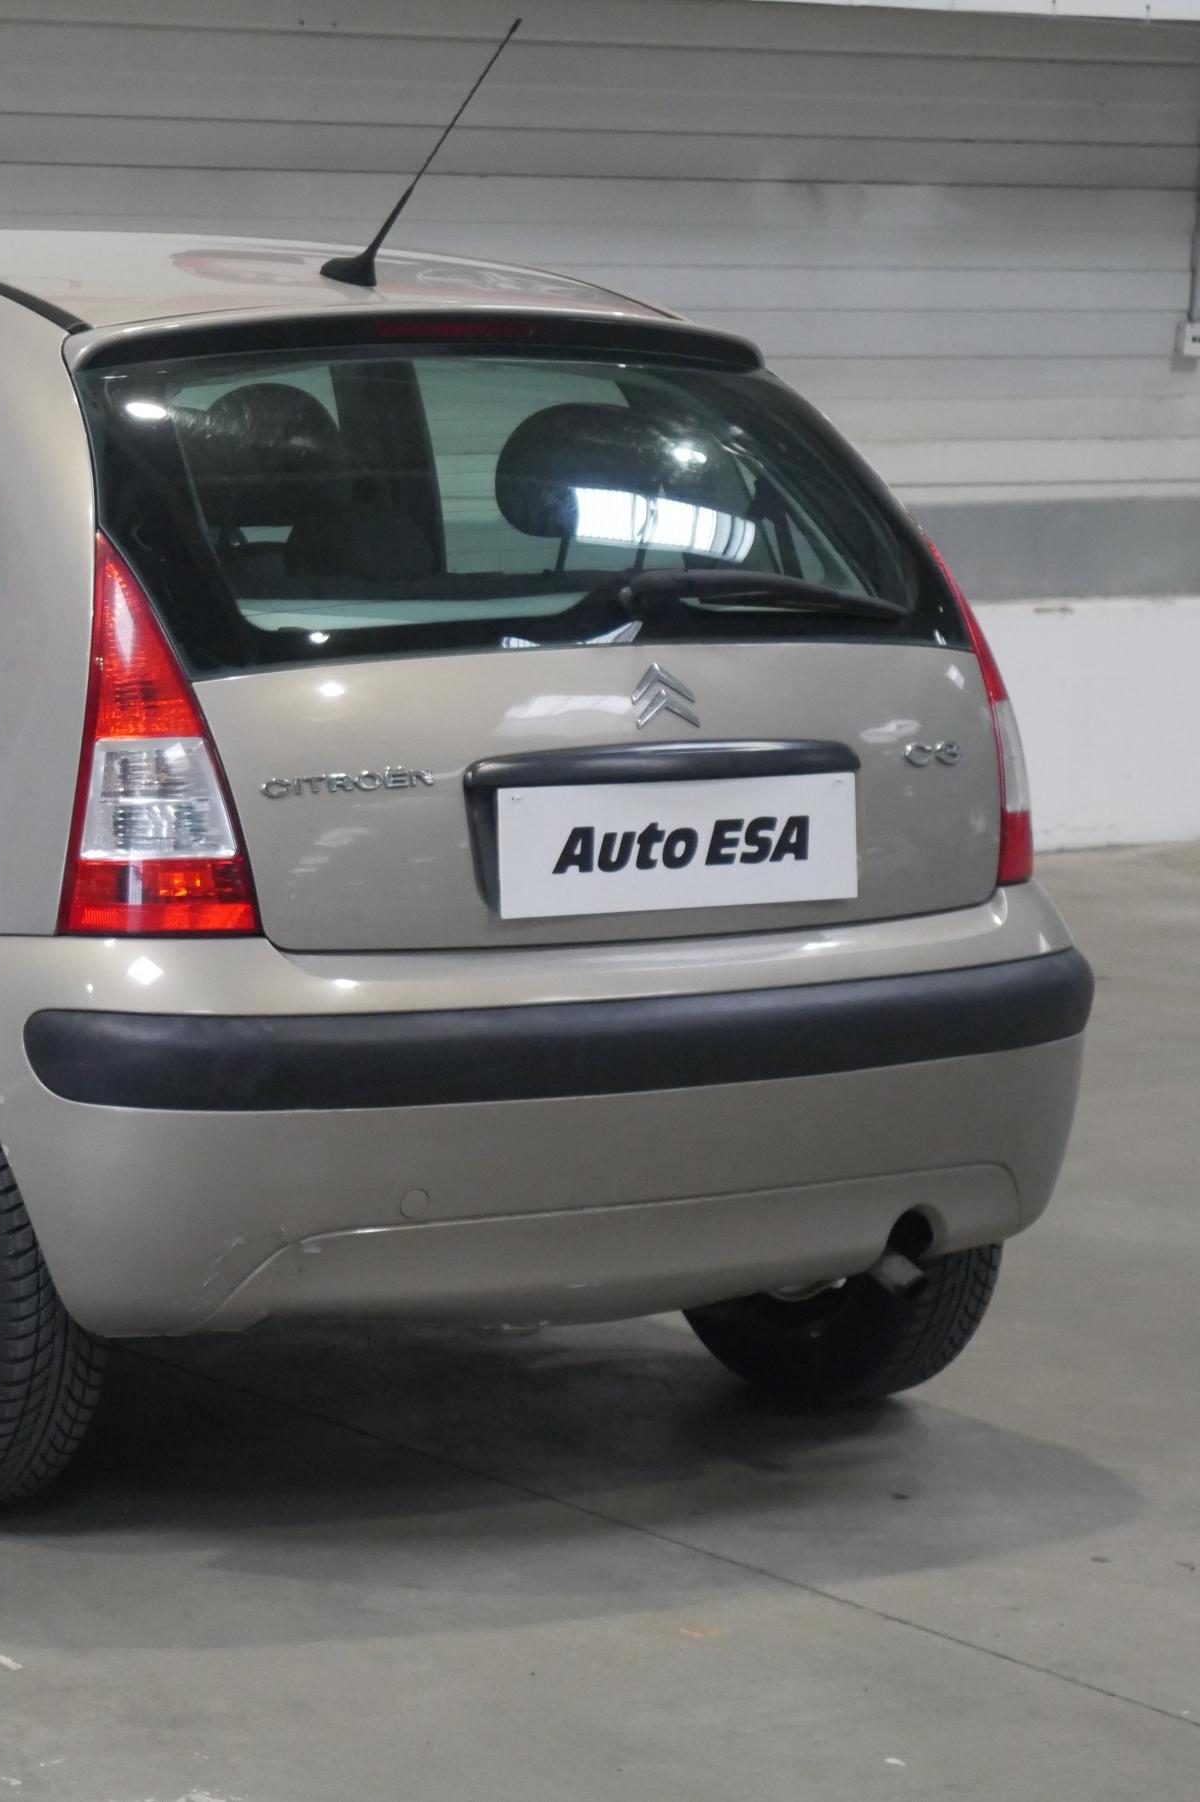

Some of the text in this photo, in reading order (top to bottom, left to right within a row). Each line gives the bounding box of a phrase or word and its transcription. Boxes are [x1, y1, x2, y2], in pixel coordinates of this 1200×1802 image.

[261, 765, 434, 799] CITROËN
[552, 815, 810, 874] Auto ESA
